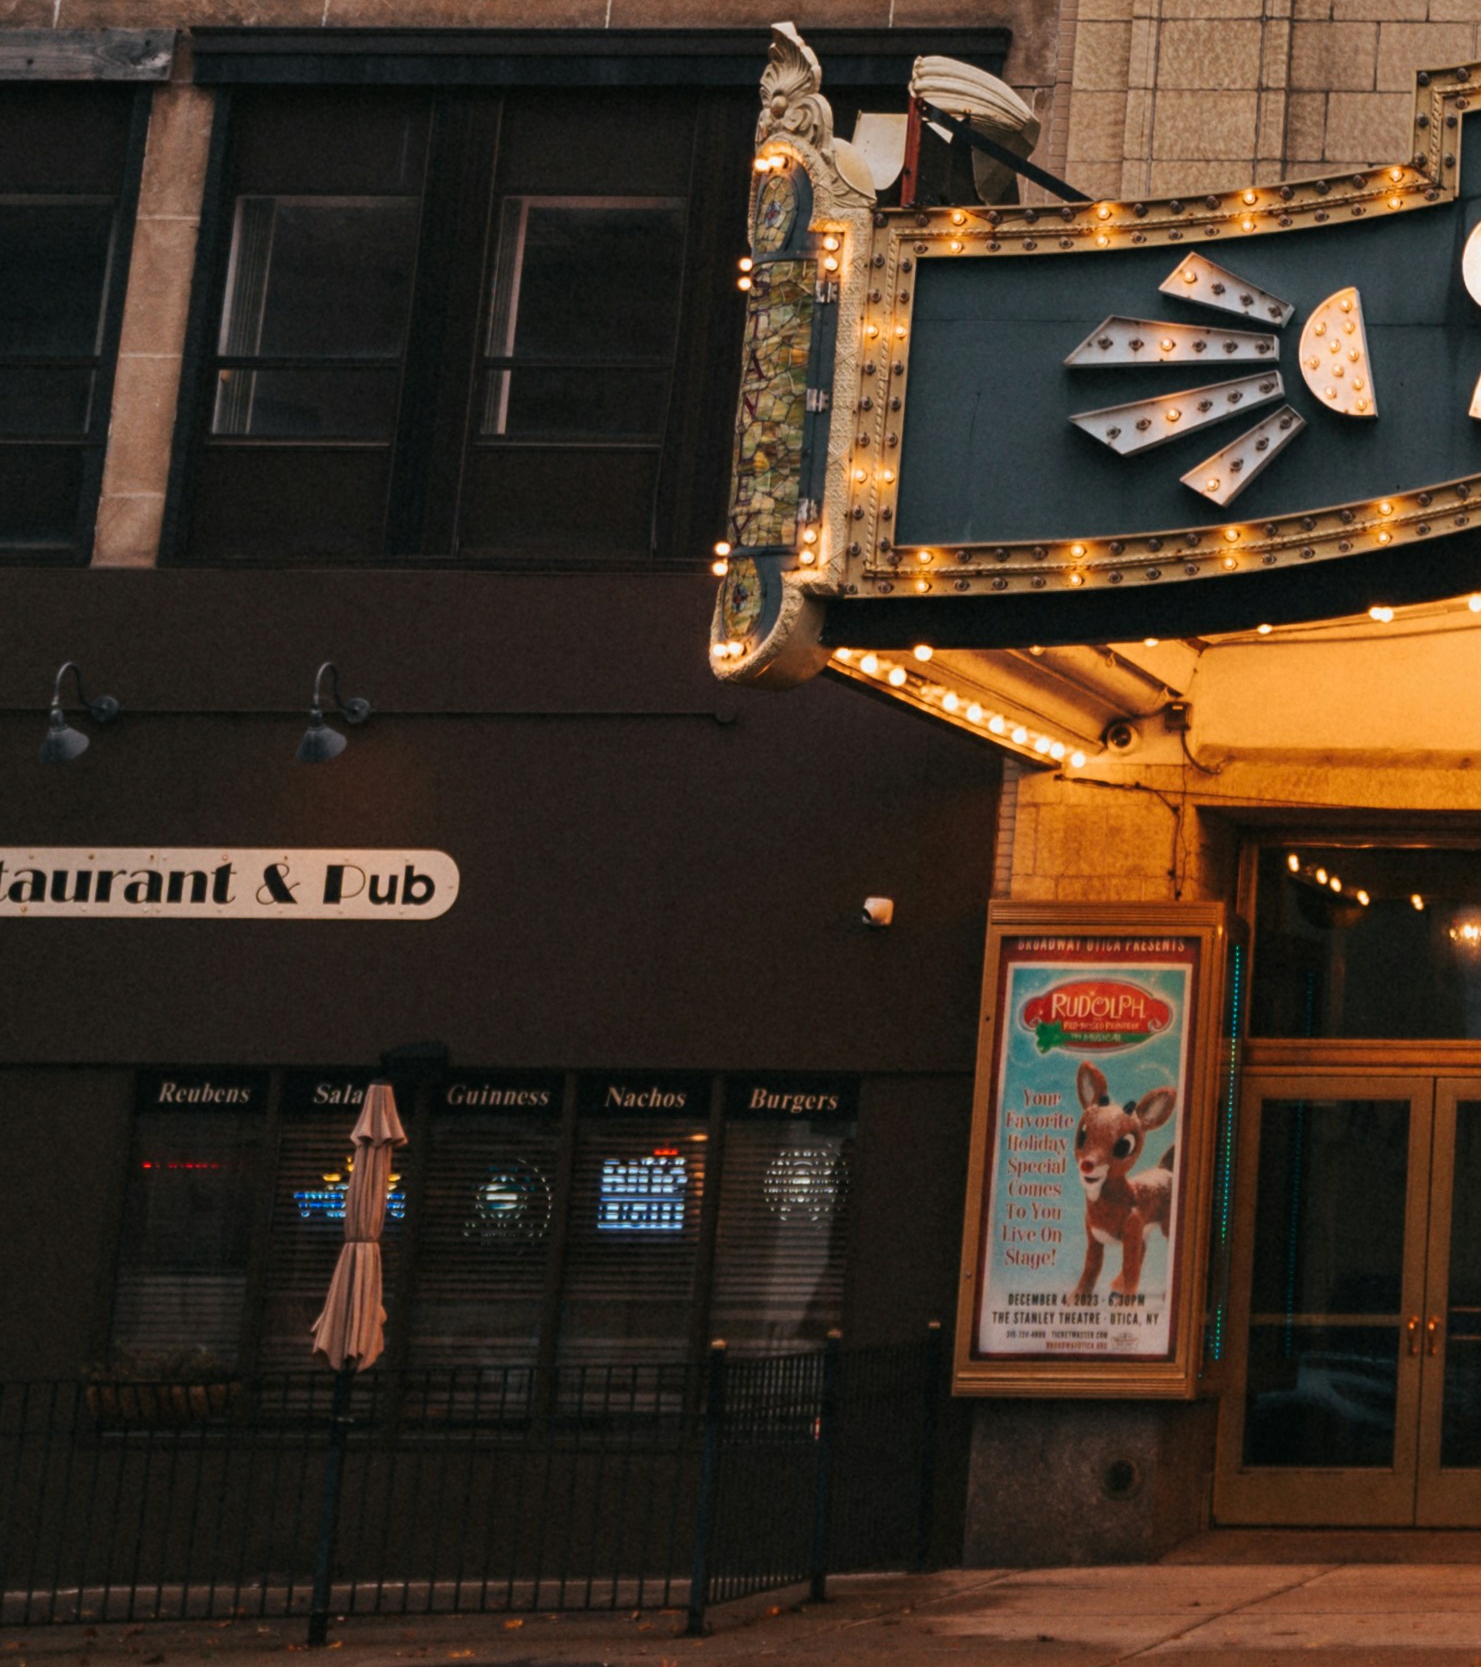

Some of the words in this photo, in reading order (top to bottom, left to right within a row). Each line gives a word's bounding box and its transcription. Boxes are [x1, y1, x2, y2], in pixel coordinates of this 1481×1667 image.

[256, 862, 300, 906] &
[322, 863, 436, 906] Pub
[1051, 992, 1147, 1019] RUDOLPH
[158, 1082, 250, 1104] Reubens
[313, 1083, 364, 1105] Sala
[446, 1083, 550, 1106] Guinness
[605, 1085, 687, 1109] Nachos
[750, 1087, 838, 1113] Burgers
[1023, 1088, 1062, 1107] Your
[1006, 1110, 1074, 1129] Favorite
[1007, 1133, 1068, 1156] Holiday
[1007, 1156, 1066, 1179] Special
[1008, 1179, 1062, 1197] Comes
[1007, 1202, 1026, 1221] To
[1031, 1201, 1062, 1221] You
[1002, 1224, 1036, 1243] Live
[1041, 1225, 1063, 1244] On
[1004, 1247, 1057, 1271] Stage!
[1008, 1292, 1057, 1307] DECEMBER
[1061, 1293, 1071, 1308] 4,
[1074, 1294, 1098, 1307] 2023
[992, 1311, 1010, 1325] THE
[1013, 1311, 1055, 1325] STANLEY
[1059, 1312, 1101, 1325] THEATRE
[1110, 1312, 1142, 1327] UTICA,
[1146, 1313, 1159, 1325] NY
